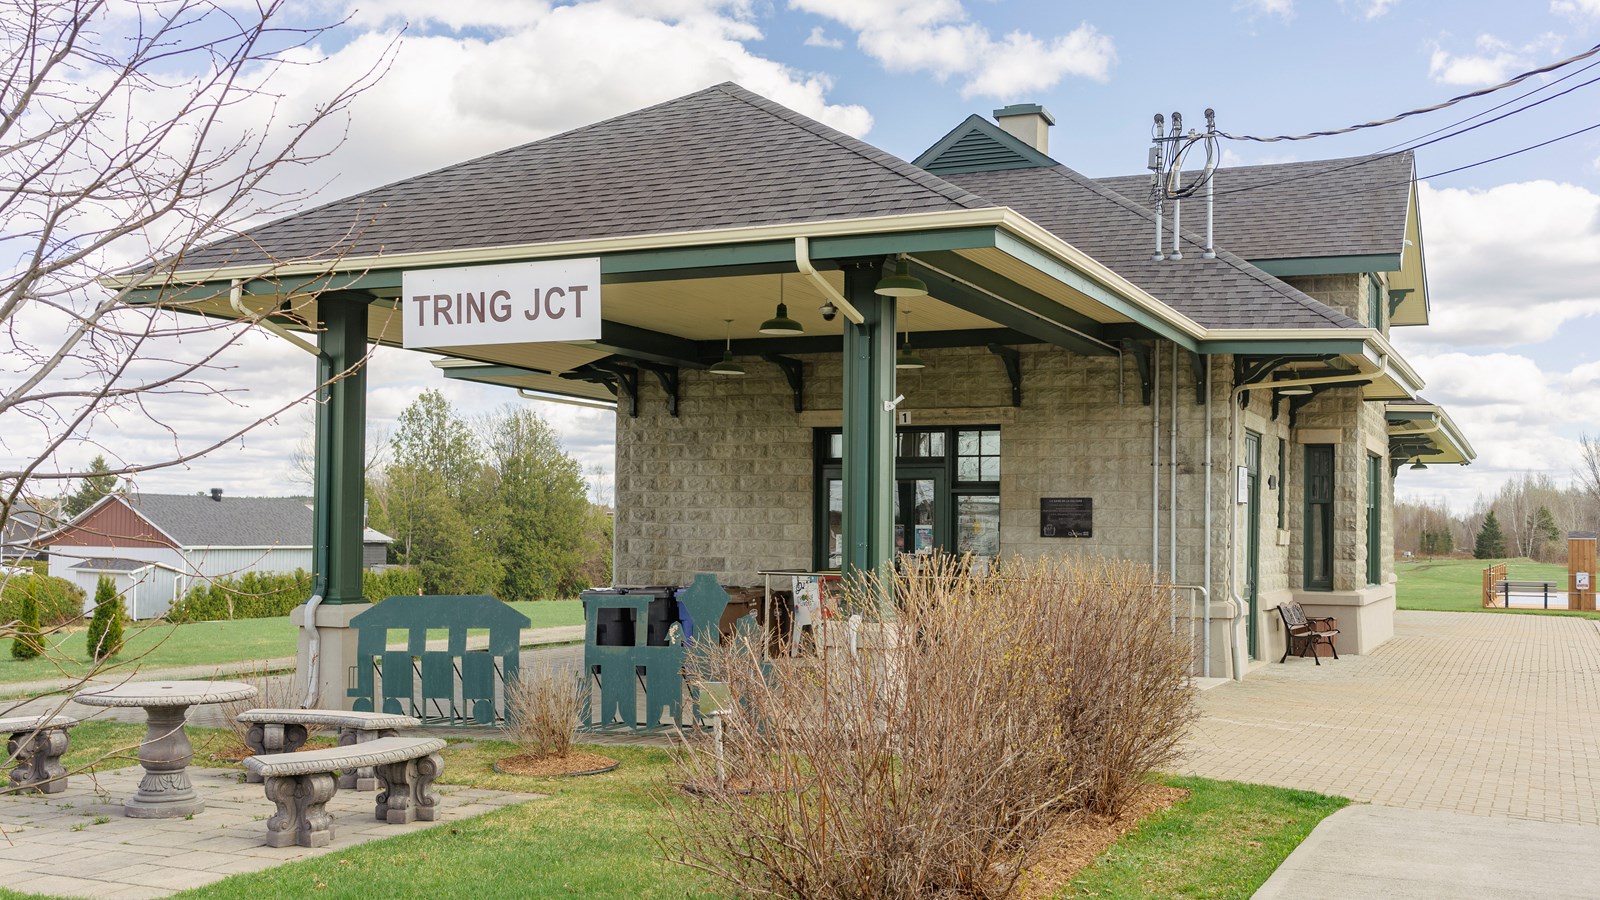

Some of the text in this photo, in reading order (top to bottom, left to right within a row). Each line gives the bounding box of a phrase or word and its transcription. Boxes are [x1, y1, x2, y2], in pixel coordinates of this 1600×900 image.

[412, 285, 589, 327] TRING JCT
[902, 412, 907, 423] 1
